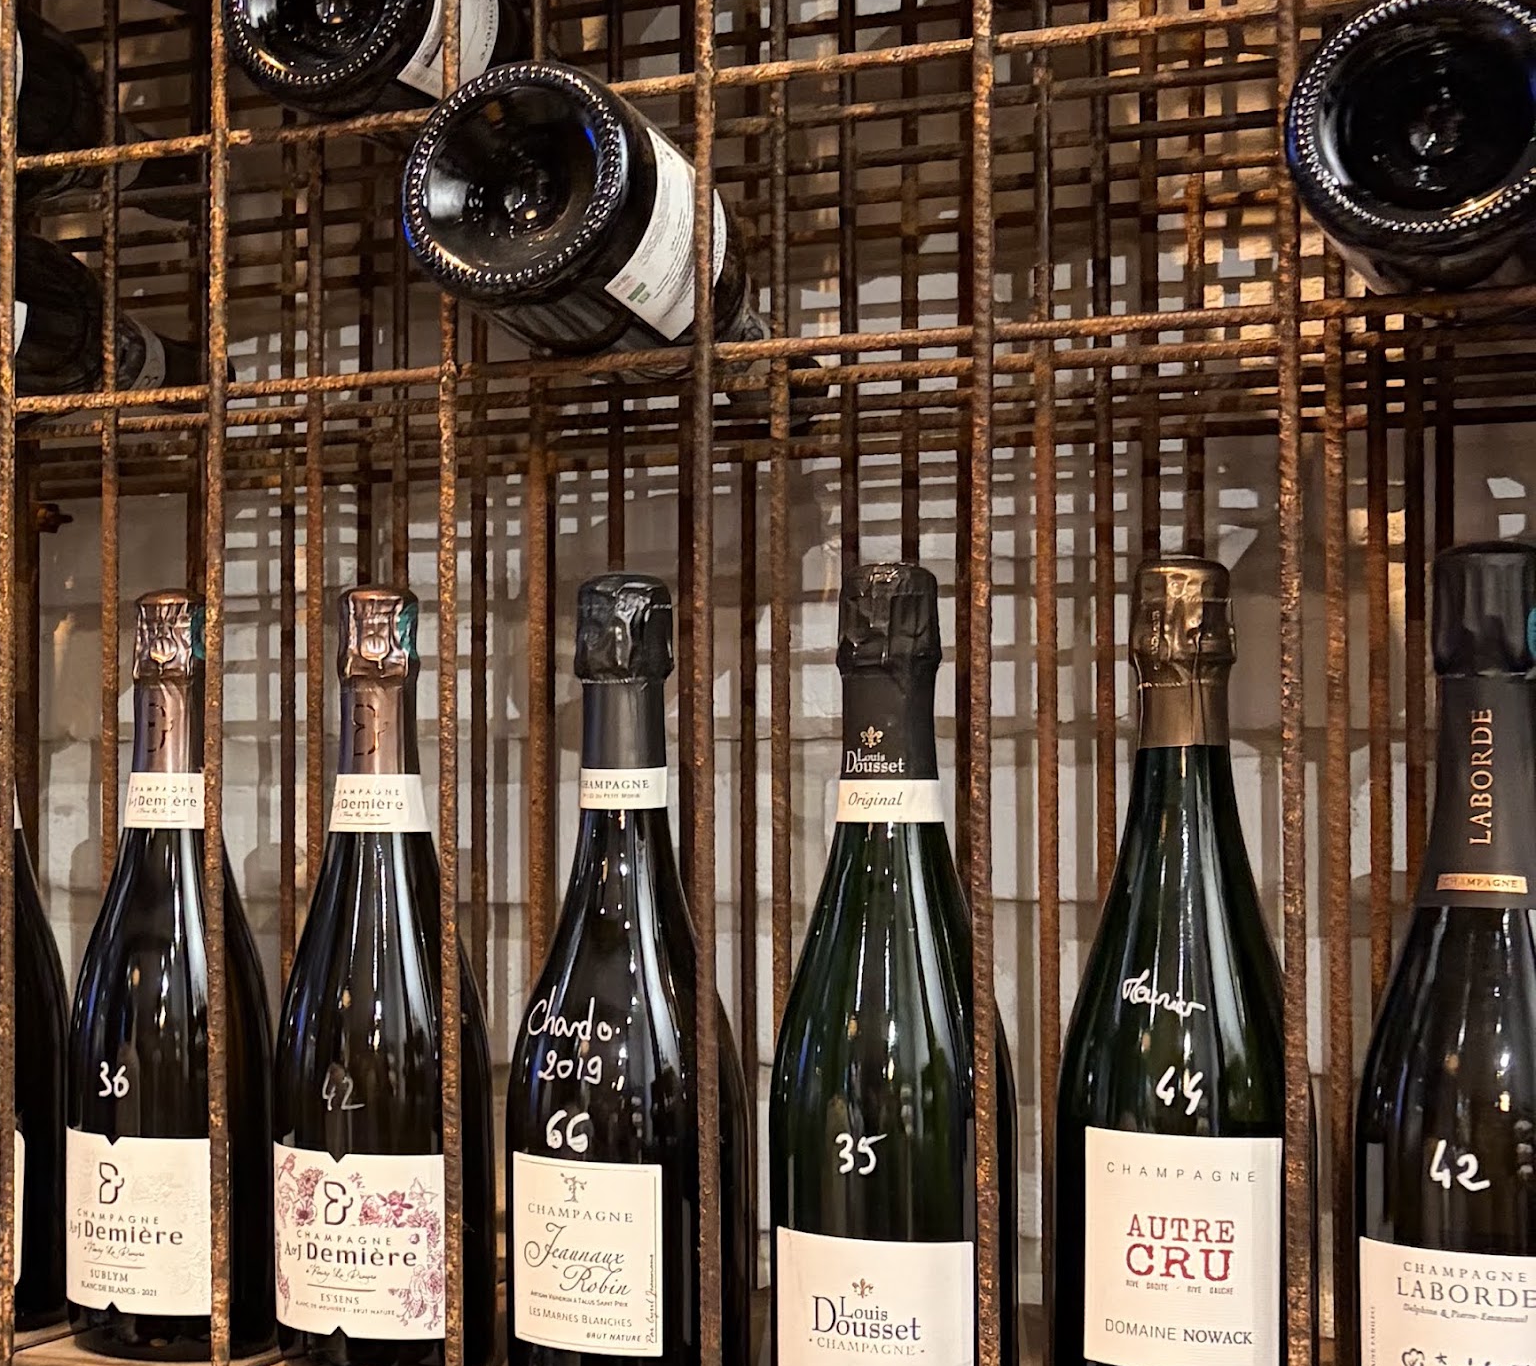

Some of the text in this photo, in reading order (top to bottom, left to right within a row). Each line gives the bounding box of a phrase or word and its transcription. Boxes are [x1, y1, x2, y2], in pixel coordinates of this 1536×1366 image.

[846, 750, 905, 775] Dousset
[857, 747, 886, 762] Louis
[1469, 708, 1495, 846] LABORDE
[341, 798, 405, 811] Demière
[847, 790, 904, 811] Original
[1440, 875, 1519, 890] CHAMPAGNE
[98, 1060, 131, 1098] 36
[537, 1049, 603, 1085] 2019
[321, 1064, 365, 1112] 42
[1155, 1065, 1204, 1116] 44
[545, 1109, 590, 1153] 66
[835, 1132, 888, 1176] 35
[1429, 1138, 1491, 1192] 42
[1106, 1160, 1257, 1184] CHAMPAGNE
[76, 1207, 159, 1226] CHAMPAGNE
[527, 1202, 634, 1224] CHAMPAGNE
[84, 1220, 184, 1246] Demière
[296, 1229, 392, 1246] CHAMPAGNE
[1125, 1213, 1235, 1244] AUTRE
[307, 1241, 418, 1267] Demière
[523, 1222, 625, 1268] Jeaunaux
[1124, 1242, 1234, 1283] CRU
[1403, 1260, 1528, 1283] CHAMPAGNE
[89, 1269, 129, 1283] SUBLYM
[108, 1285, 158, 1297] BLANCS 2021
[1396, 1276, 1536, 1310] LABORDE
[528, 1305, 633, 1329] LES MARNES BLANCHES
[811, 1295, 922, 1341] Dousset
[839, 1295, 889, 1322] Louis
[586, 1330, 642, 1343] BRUT NATURE
[1104, 1317, 1253, 1346] DOMAINE NOWACK
[817, 1336, 916, 1357] CHAMPAGNE
